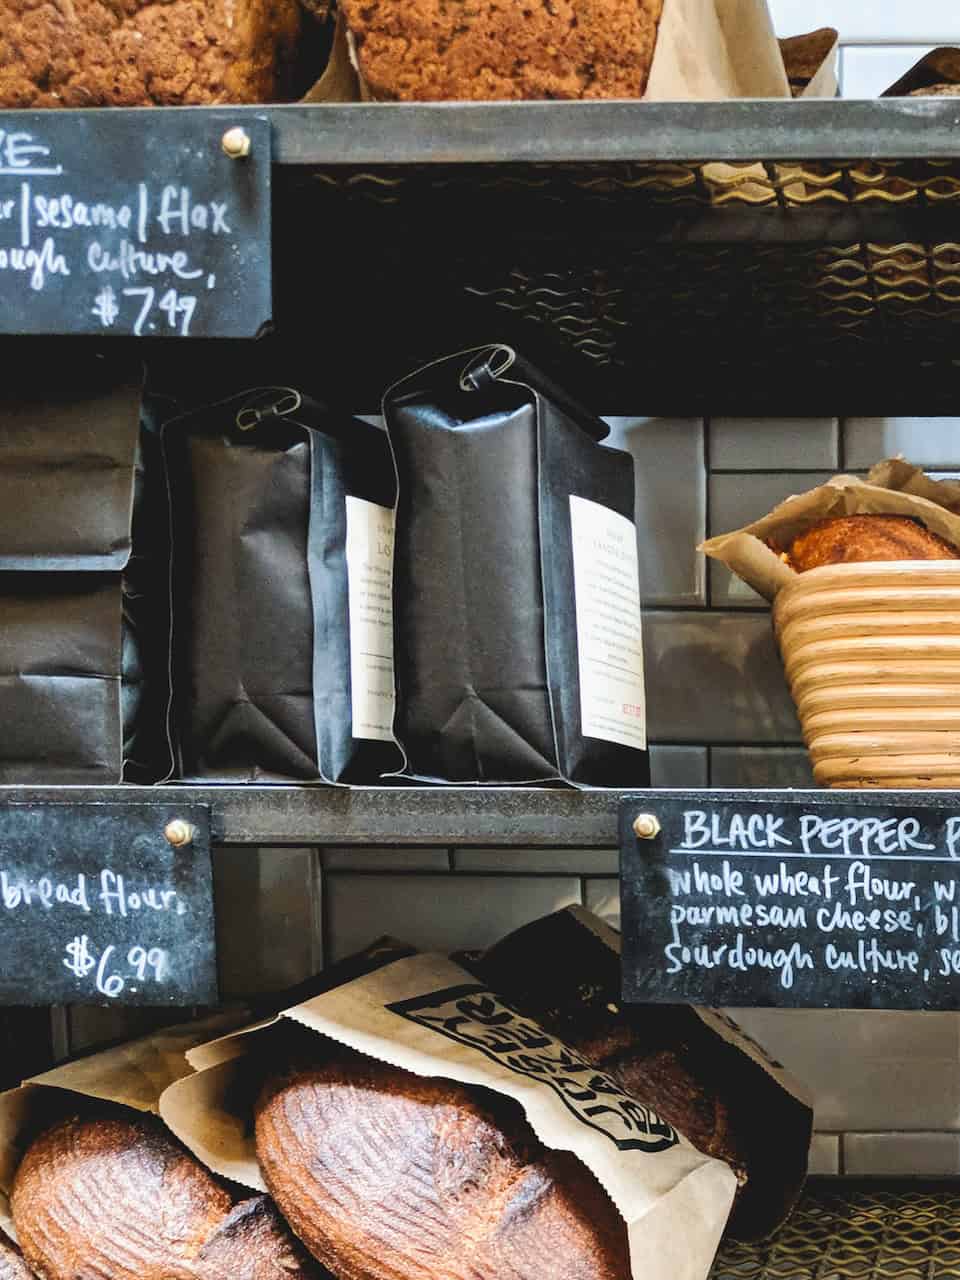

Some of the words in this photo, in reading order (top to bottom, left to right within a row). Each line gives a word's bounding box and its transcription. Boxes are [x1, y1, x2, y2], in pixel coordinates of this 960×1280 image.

[91, 285, 197, 337] $7.49
[680, 810, 792, 849] BLACK
[799, 814, 936, 856] PEPPER
[0, 870, 92, 912] bread
[98, 868, 186, 916] flour,
[667, 860, 745, 897] whole
[754, 862, 840, 899] wheat
[844, 860, 921, 911] flour,
[670, 904, 808, 948] parmesan
[816, 902, 923, 938] cheese,
[62, 934, 166, 998] $6.99
[416, 1013, 632, 1130] JOSEY
